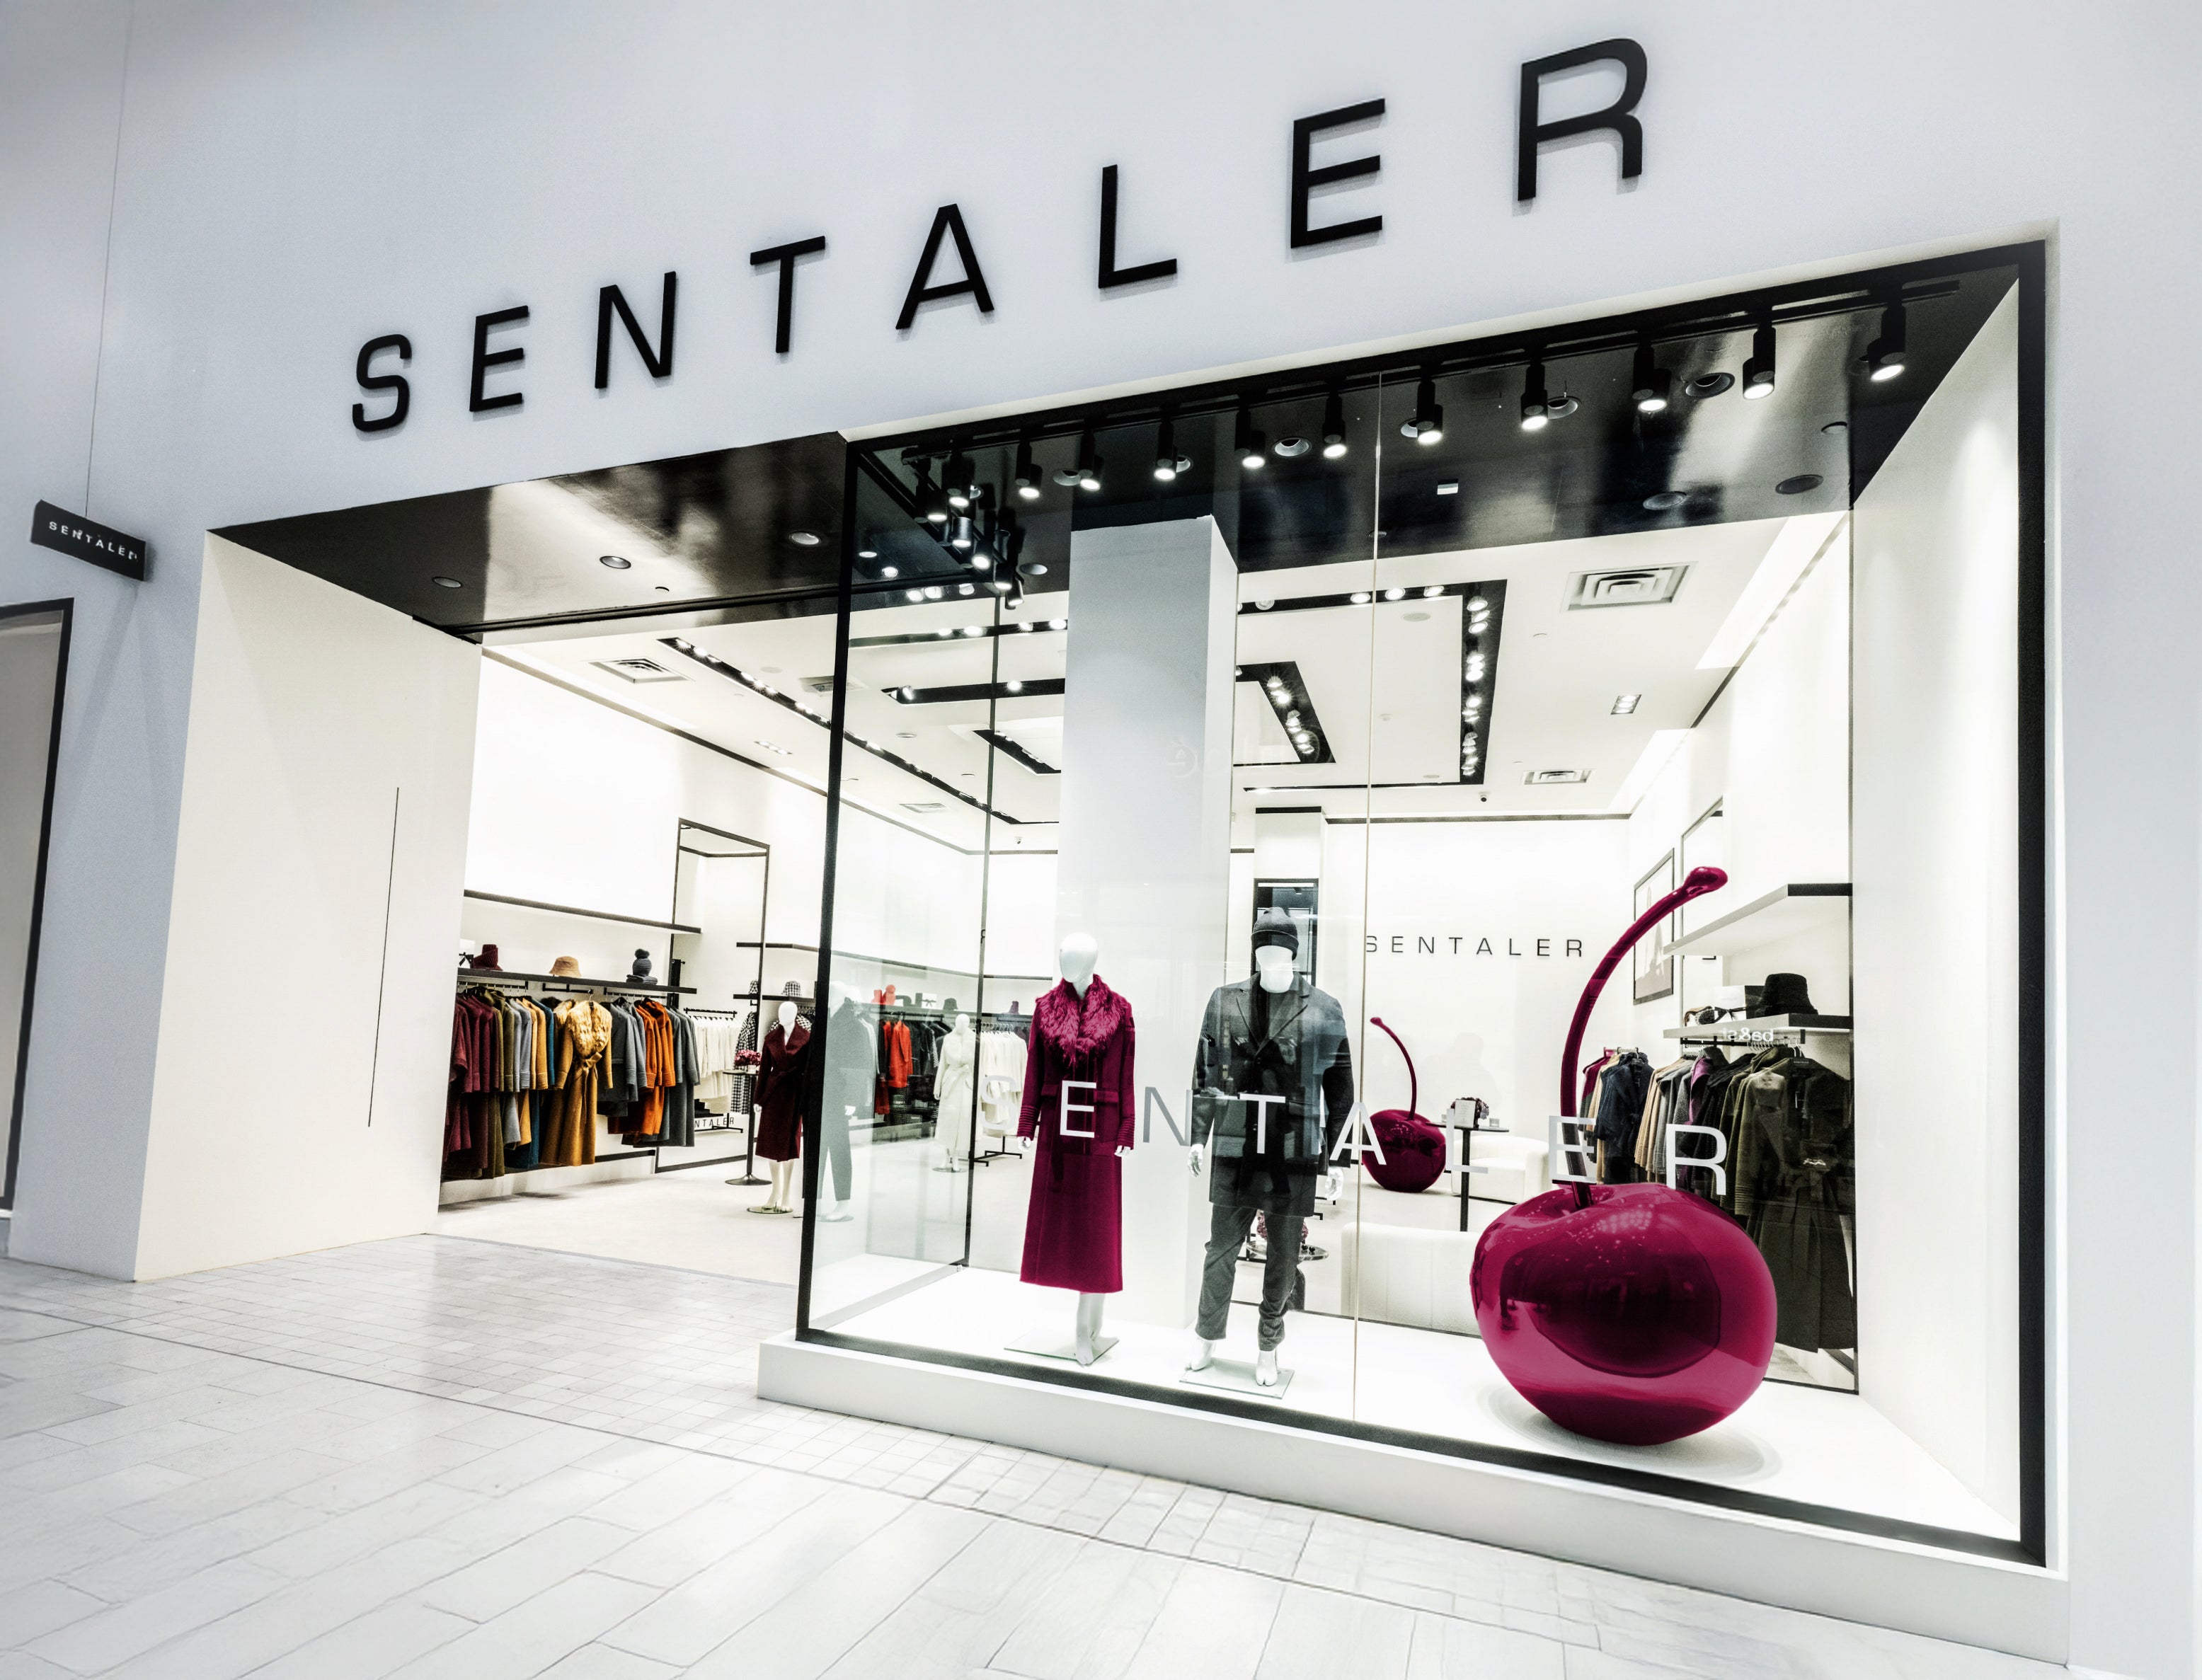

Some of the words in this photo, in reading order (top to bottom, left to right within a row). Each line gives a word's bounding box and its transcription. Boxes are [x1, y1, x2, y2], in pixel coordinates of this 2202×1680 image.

[352, 39, 1648, 432] SENTALER
[1365, 935, 1583, 957] SENTALER
[980, 1075, 1727, 1195] SENTALER
